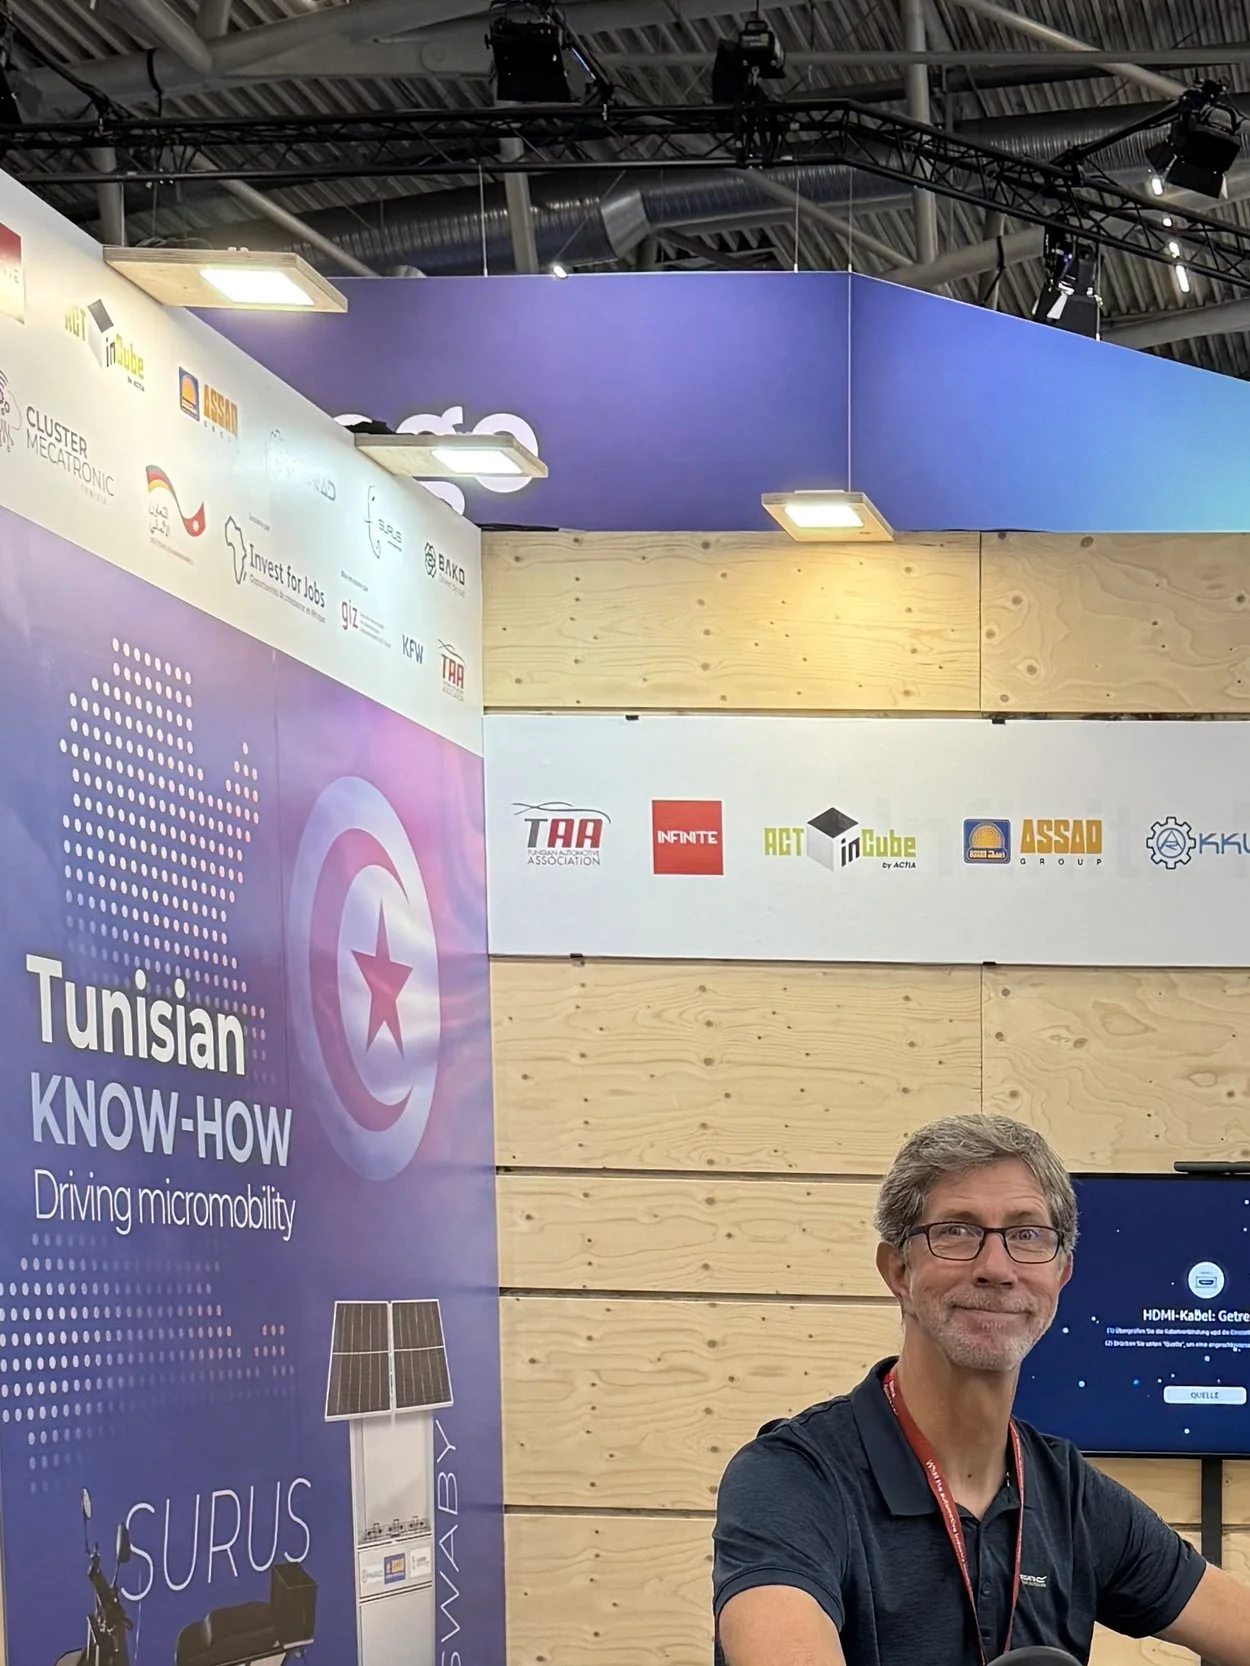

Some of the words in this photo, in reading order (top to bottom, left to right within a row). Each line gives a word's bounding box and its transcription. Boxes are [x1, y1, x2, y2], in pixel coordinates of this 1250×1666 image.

[26, 406, 88, 460] CLUSTER
[26, 430, 115, 497] MECATRONIC
[249, 543, 284, 584] Invest
[286, 566, 302, 595] for
[303, 576, 325, 608] Jobs
[341, 599, 359, 631] giz
[441, 653, 464, 690] TAA
[524, 818, 603, 849] TAA
[657, 830, 719, 845] INFINITE
[764, 827, 806, 857] ACT
[1019, 818, 1103, 854] ASSAD
[527, 855, 601, 866] ASSOCIATION
[882, 863, 892, 871] by
[893, 861, 917, 869] ACTIA
[1019, 858, 1102, 866] GROUP
[26, 954, 246, 1076] Tunisian
[31, 1071, 293, 1167] KNOW-HOW
[34, 1169, 133, 1236] Driving
[138, 1177, 296, 1242] micromobility
[1143, 1308, 1216, 1322] HDMI-Kabel:
[1190, 1391, 1219, 1400] QUELLE
[121, 1477, 312, 1601] SURUS
